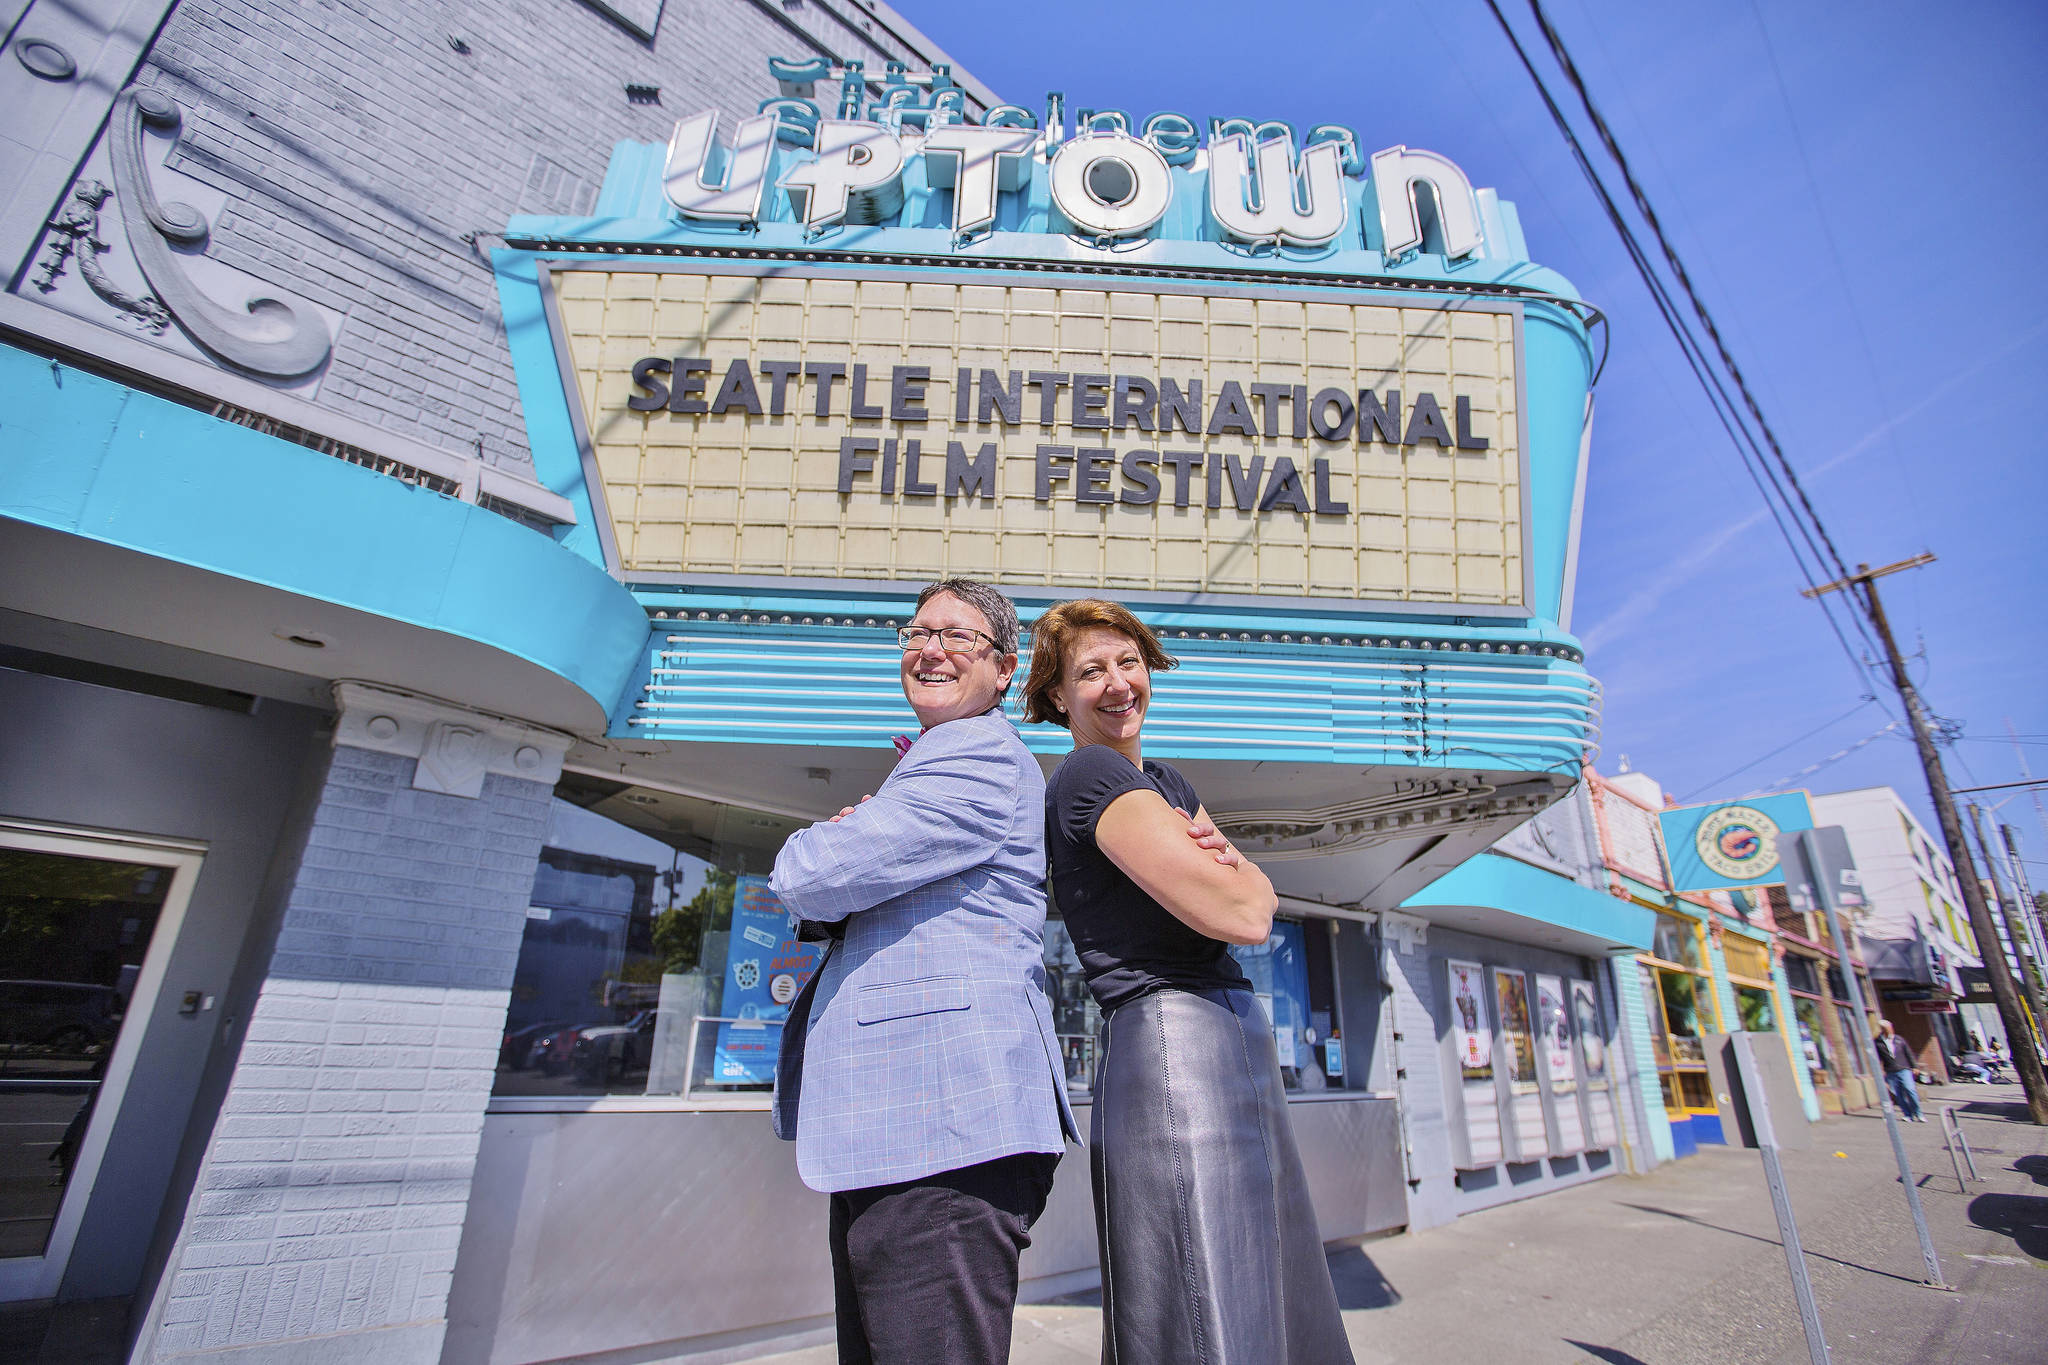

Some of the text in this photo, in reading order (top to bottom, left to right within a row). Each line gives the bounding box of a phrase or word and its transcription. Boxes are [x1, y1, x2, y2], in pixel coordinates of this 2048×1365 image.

[663, 108, 1484, 262] UPTOWN
[629, 356, 1490, 450] SEATTLE INTERNATIONAL
[837, 436, 1351, 516] FILM FESTIVAL
[769, 954, 814, 970] ALMOST
